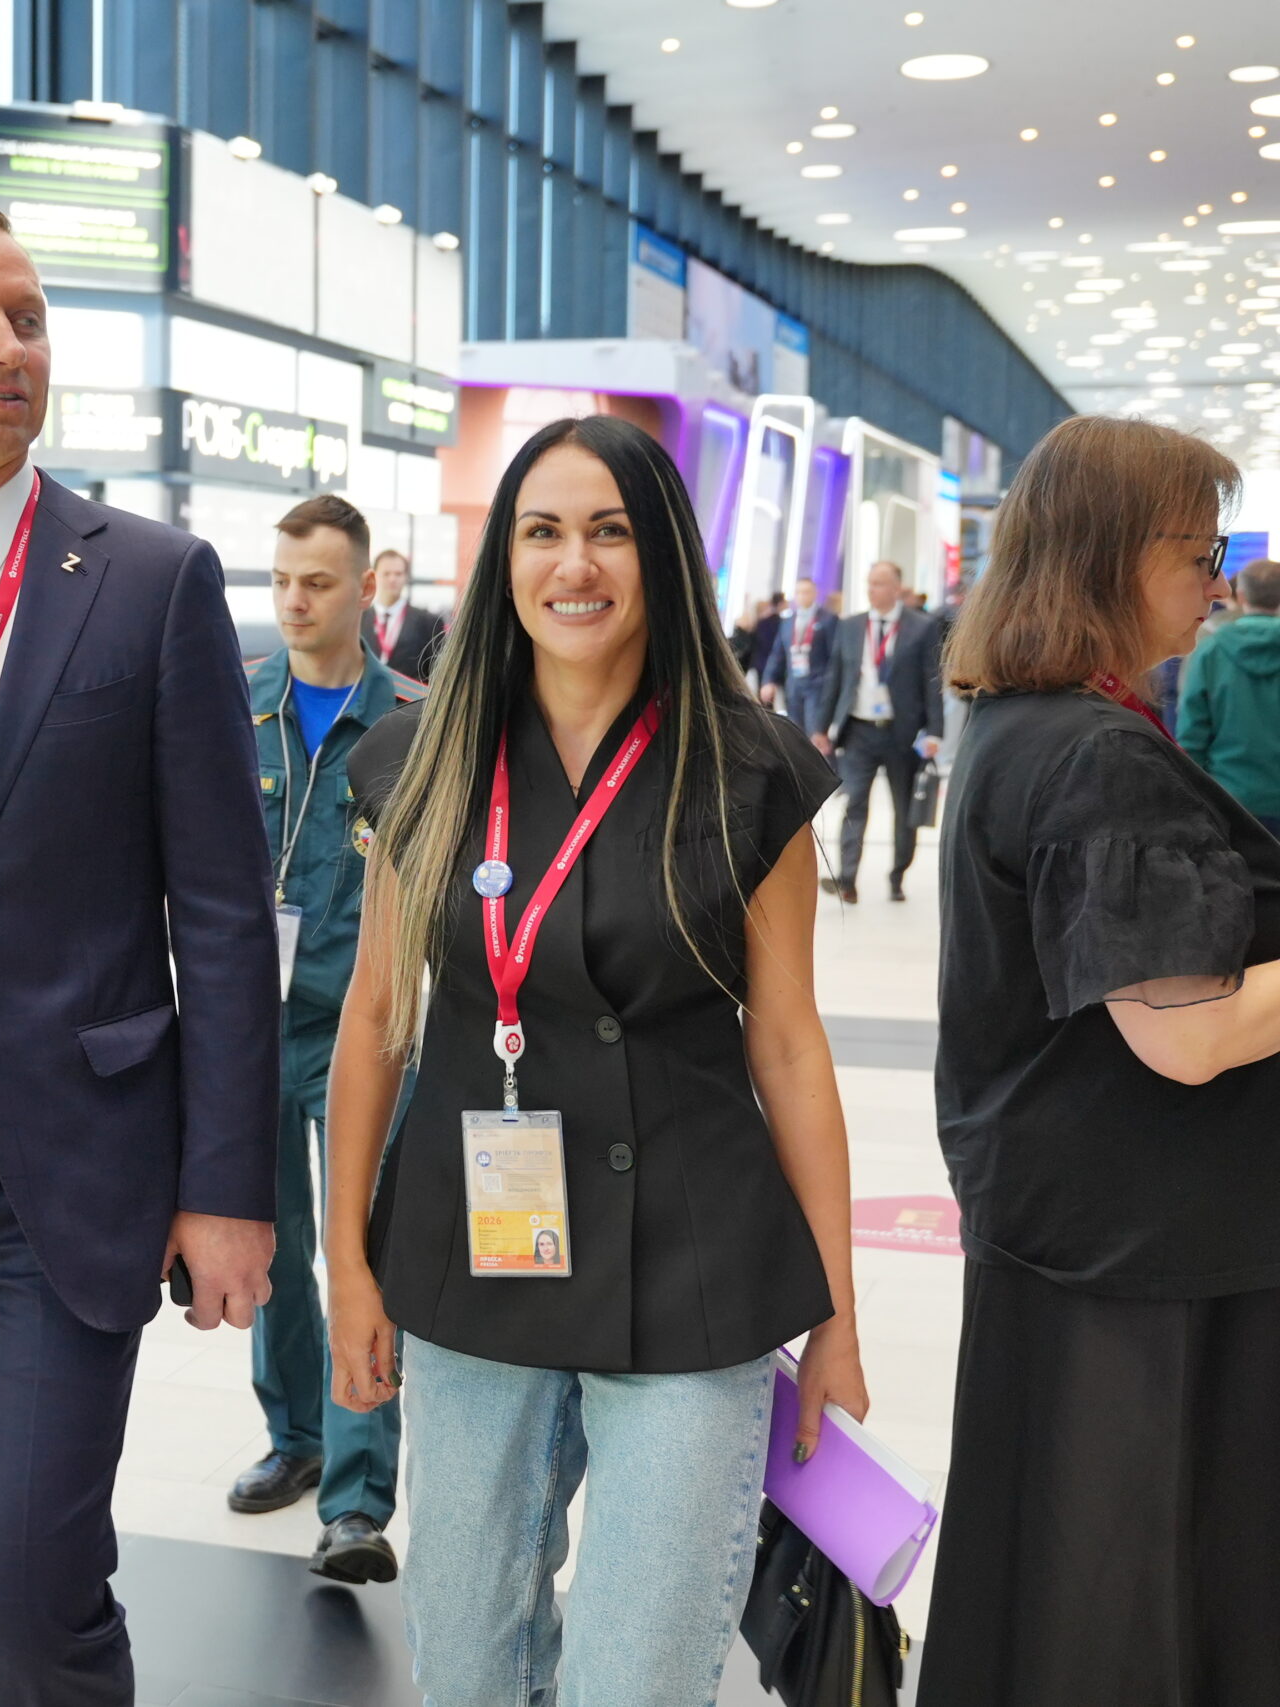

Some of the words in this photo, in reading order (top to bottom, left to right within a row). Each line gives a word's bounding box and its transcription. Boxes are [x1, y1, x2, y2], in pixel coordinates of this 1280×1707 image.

[563, 819, 591, 863] ROSCONGRESS
[489, 905, 501, 958] ROSCONGRESS
[518, 904, 542, 955] РОСКОНГРЕСС
[477, 1216, 502, 1226] 2026
